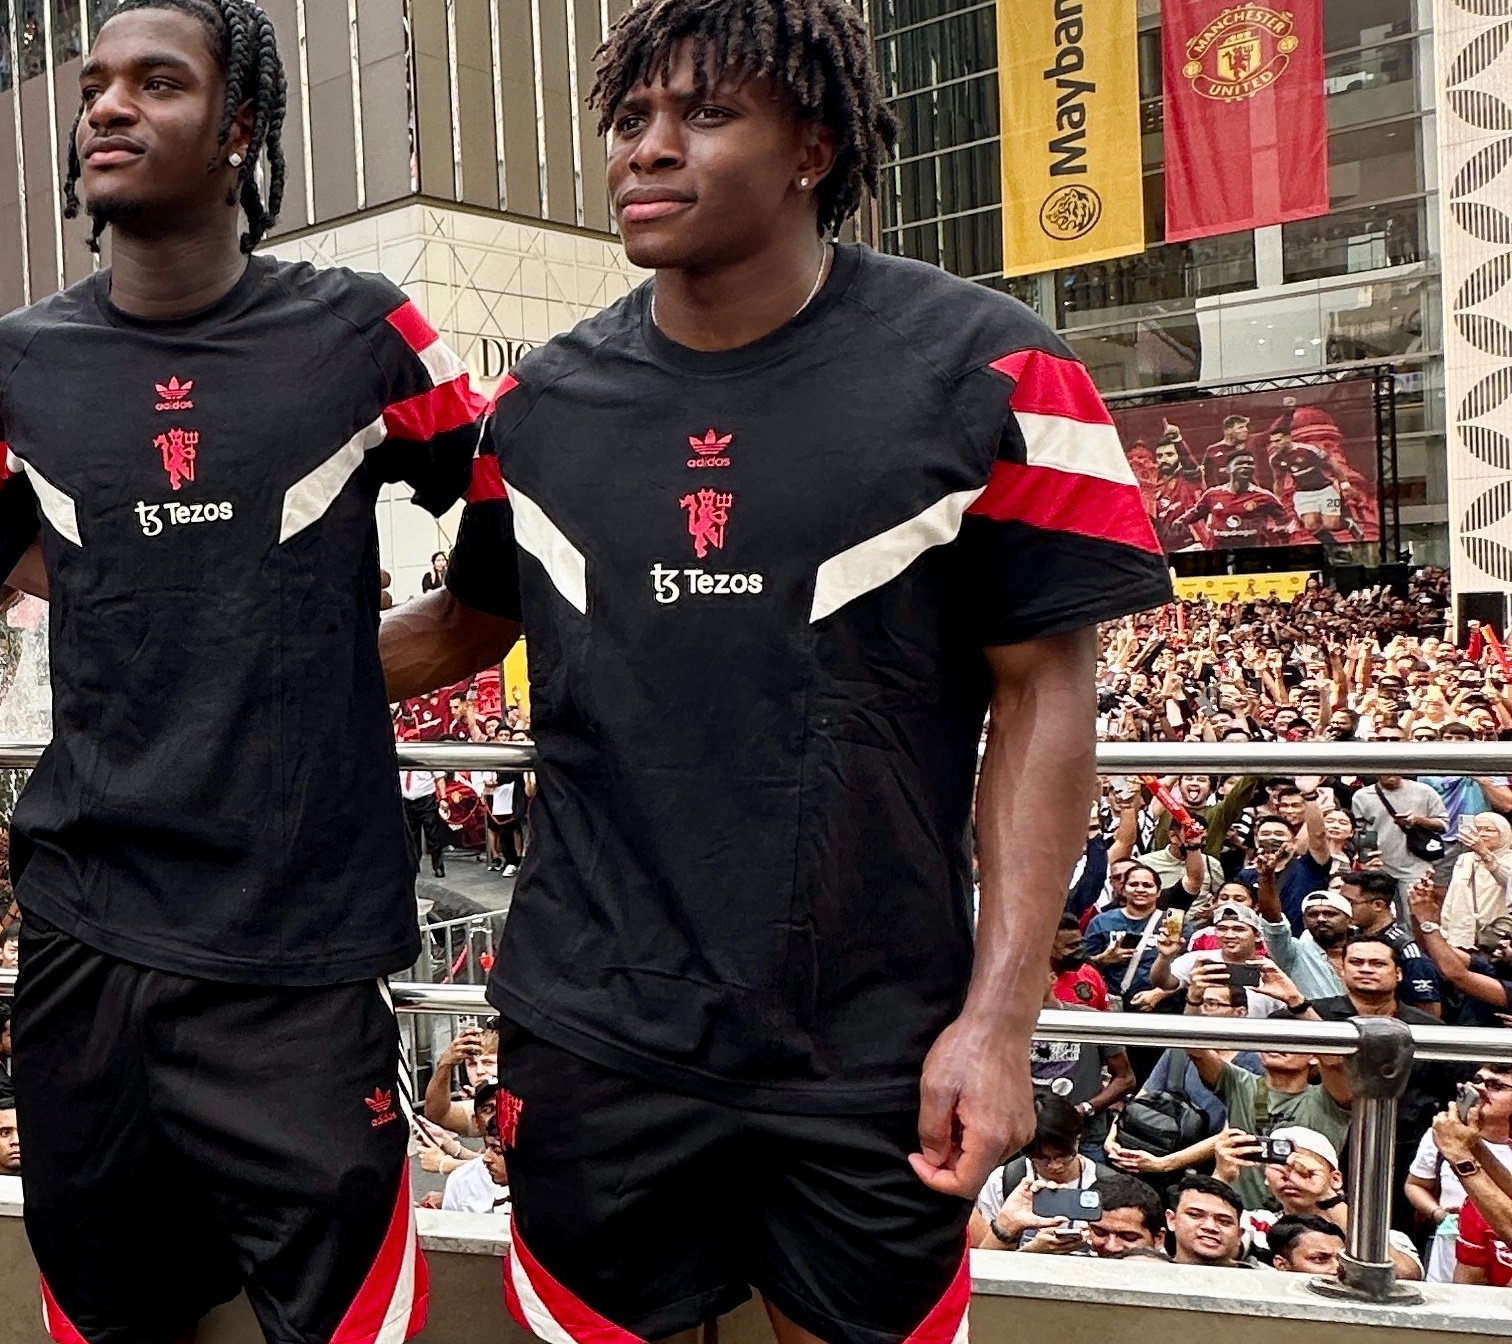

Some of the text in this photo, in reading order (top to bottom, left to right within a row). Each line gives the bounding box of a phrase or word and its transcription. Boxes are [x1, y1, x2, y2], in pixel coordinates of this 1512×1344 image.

[1193, 9, 1287, 54] MANCHESTER
[1209, 70, 1273, 96] UNITED
[687, 457, 731, 468] adidas
[163, 501, 234, 525] Tezos
[683, 569, 764, 595] Tezos
